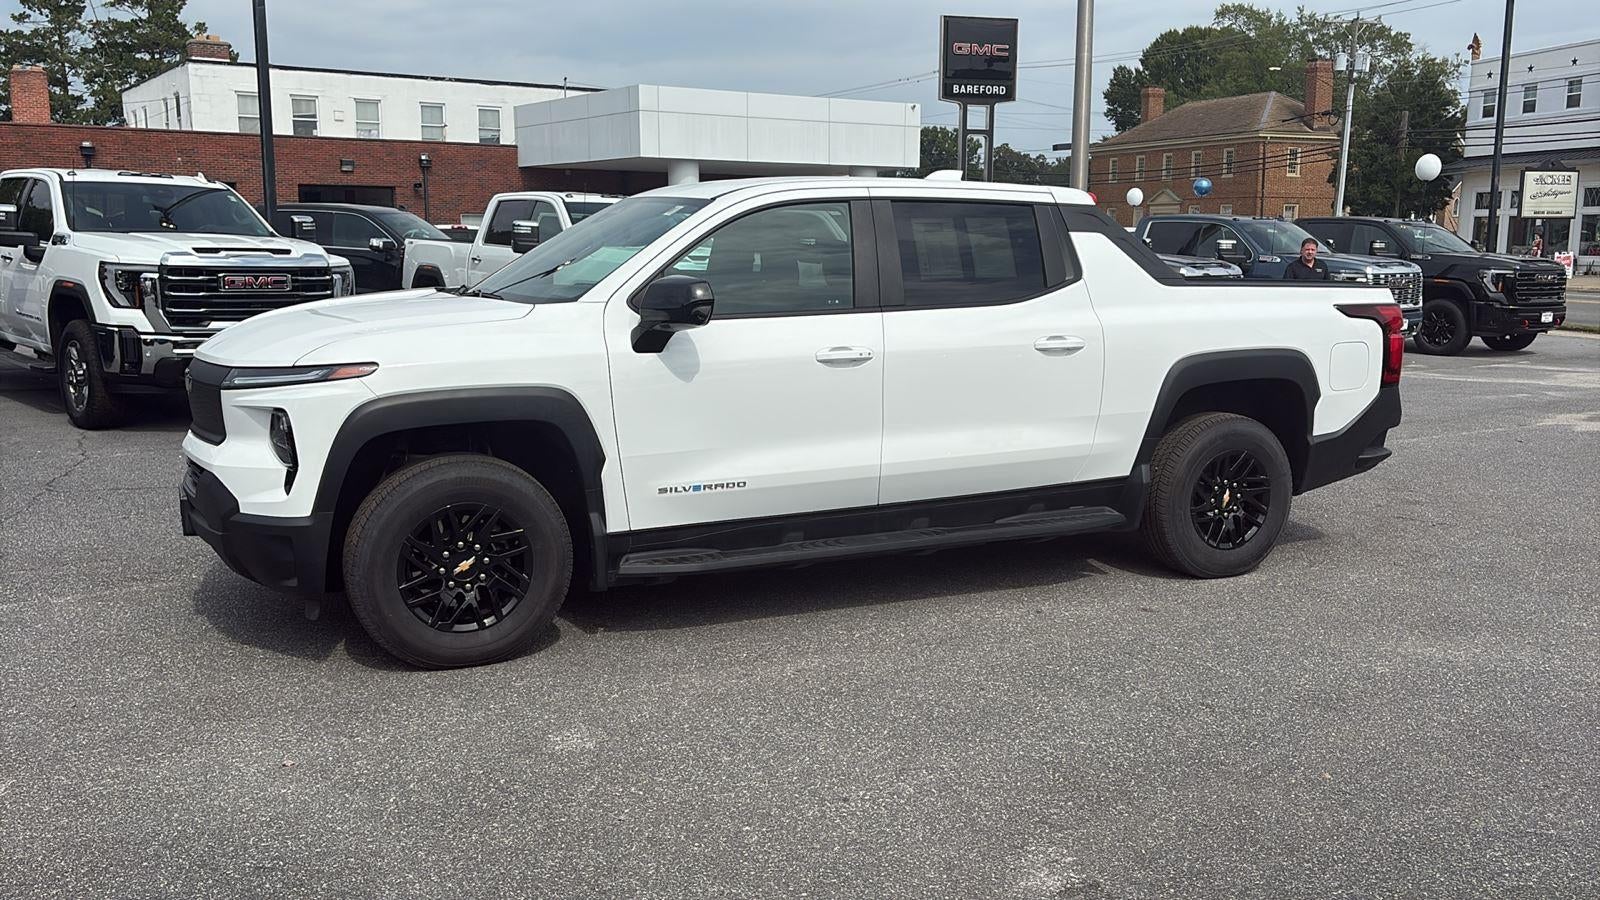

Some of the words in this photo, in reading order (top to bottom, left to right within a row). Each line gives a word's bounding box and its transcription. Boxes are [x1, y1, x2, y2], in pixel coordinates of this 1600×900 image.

[953, 42, 1009, 57] GMC
[953, 84, 1006, 95] BAREFORD
[224, 275, 288, 289] GMC
[657, 481, 747, 494] SILVERADO
